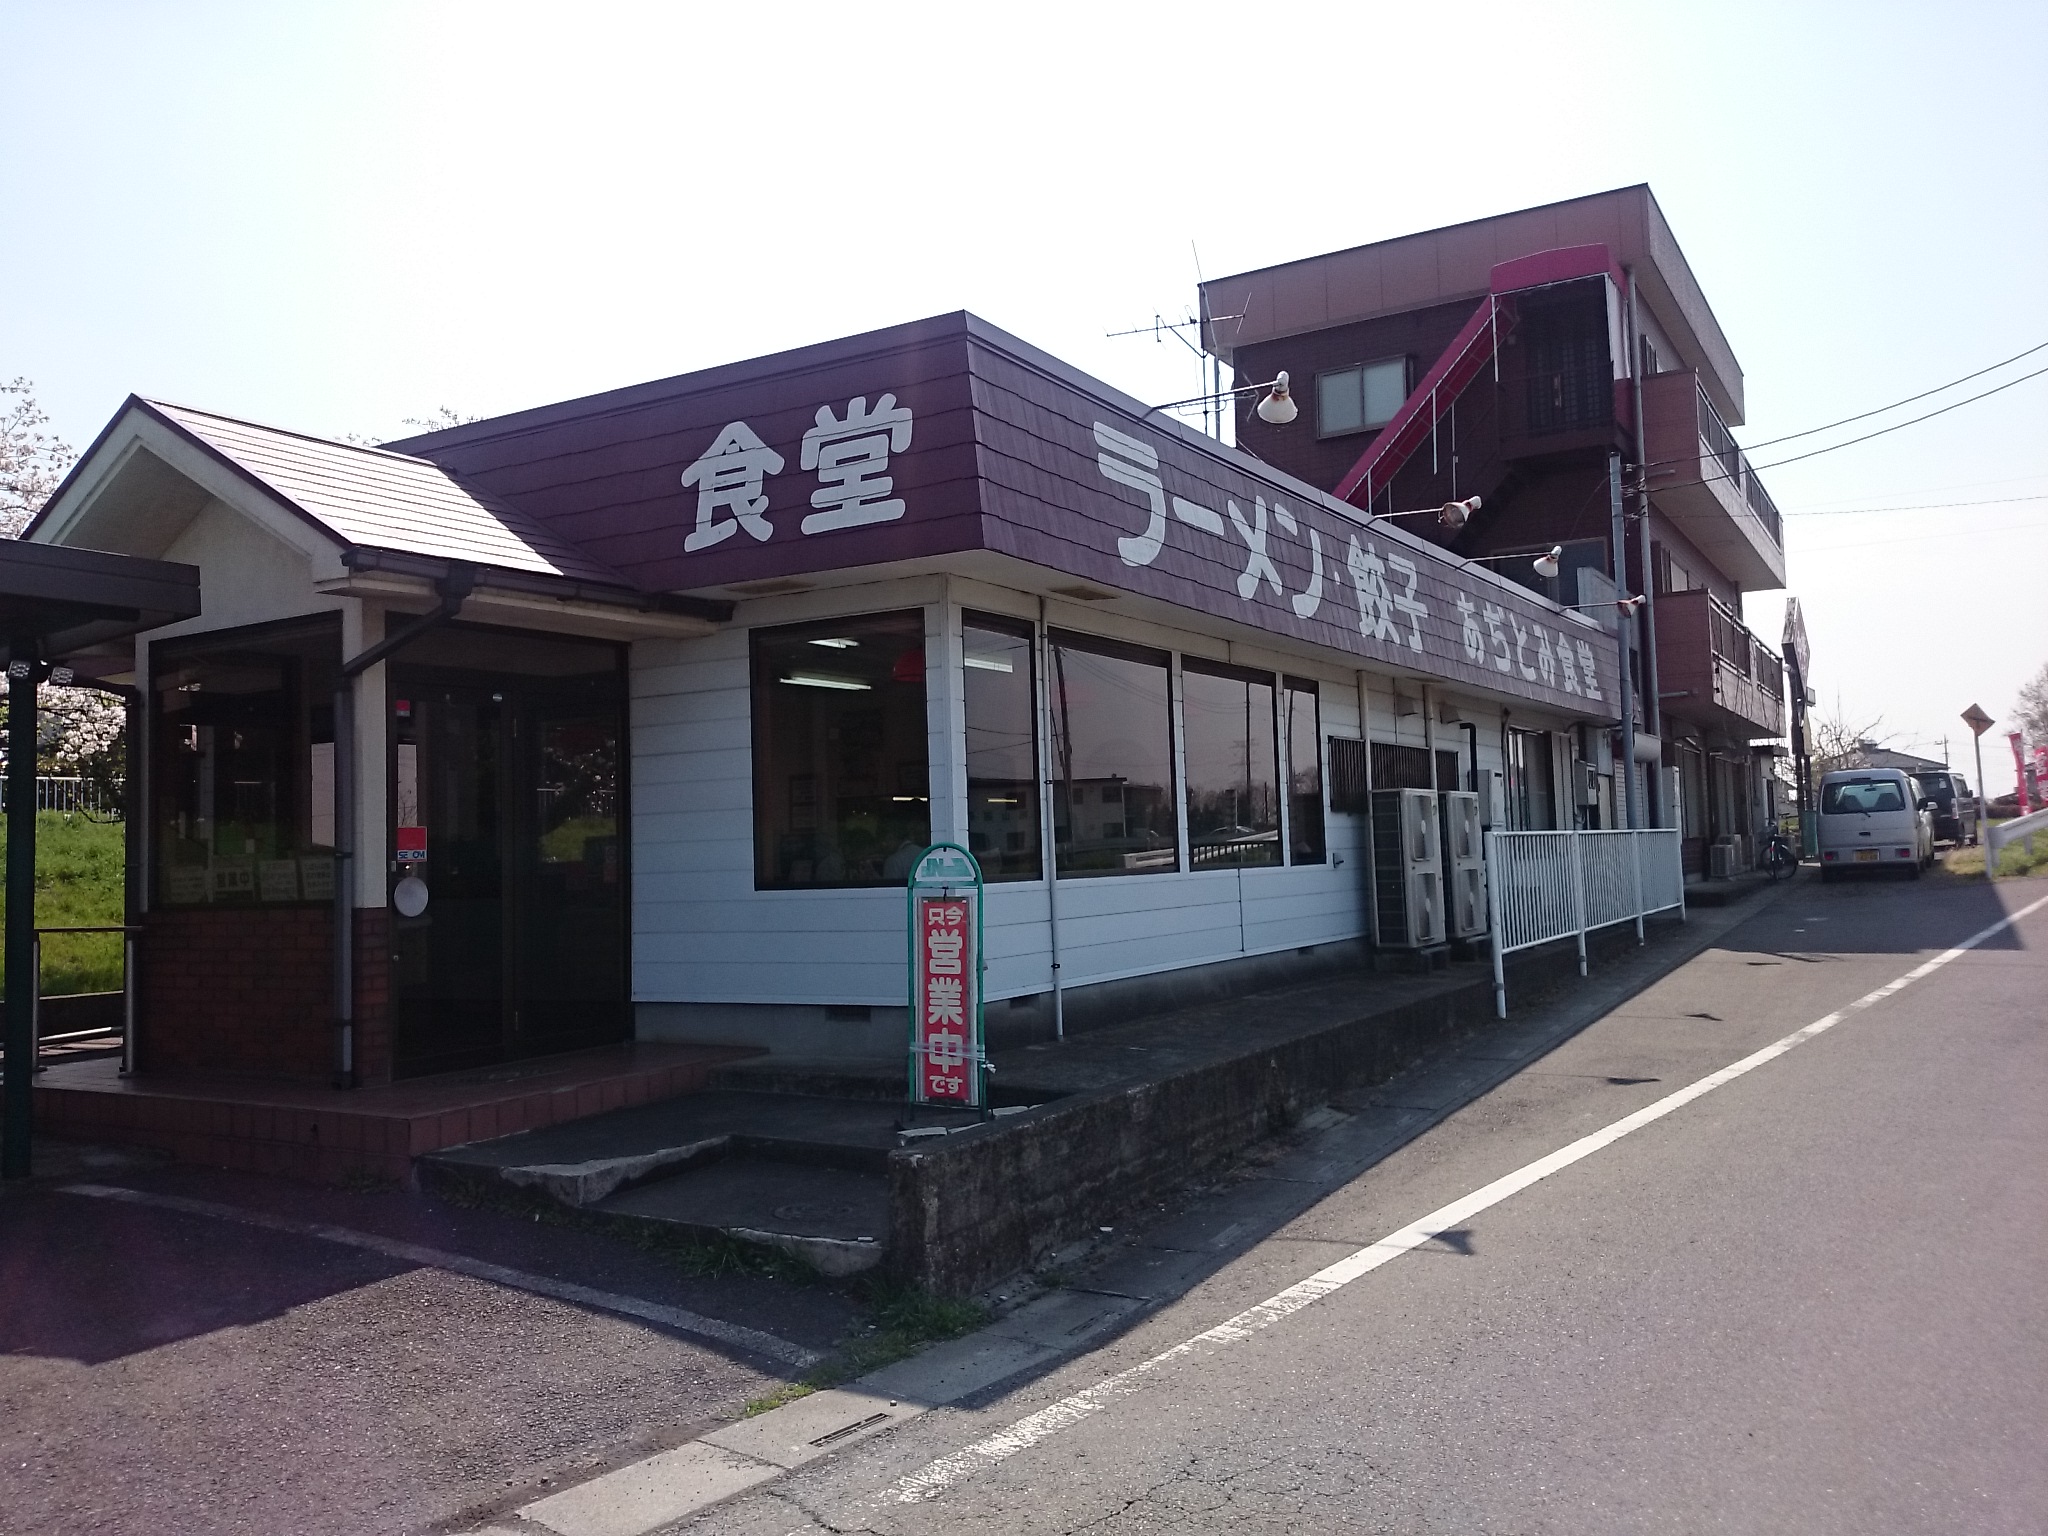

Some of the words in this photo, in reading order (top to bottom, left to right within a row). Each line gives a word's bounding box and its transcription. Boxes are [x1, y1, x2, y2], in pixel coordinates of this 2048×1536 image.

[681, 393, 913, 552] 食堂
[1457, 591, 1602, 701] あぢとみ食堂
[399, 851, 425, 859] SEOM
[928, 906, 964, 925] 只今
[928, 929, 964, 1073] 営業中
[930, 1075, 963, 1095] です
